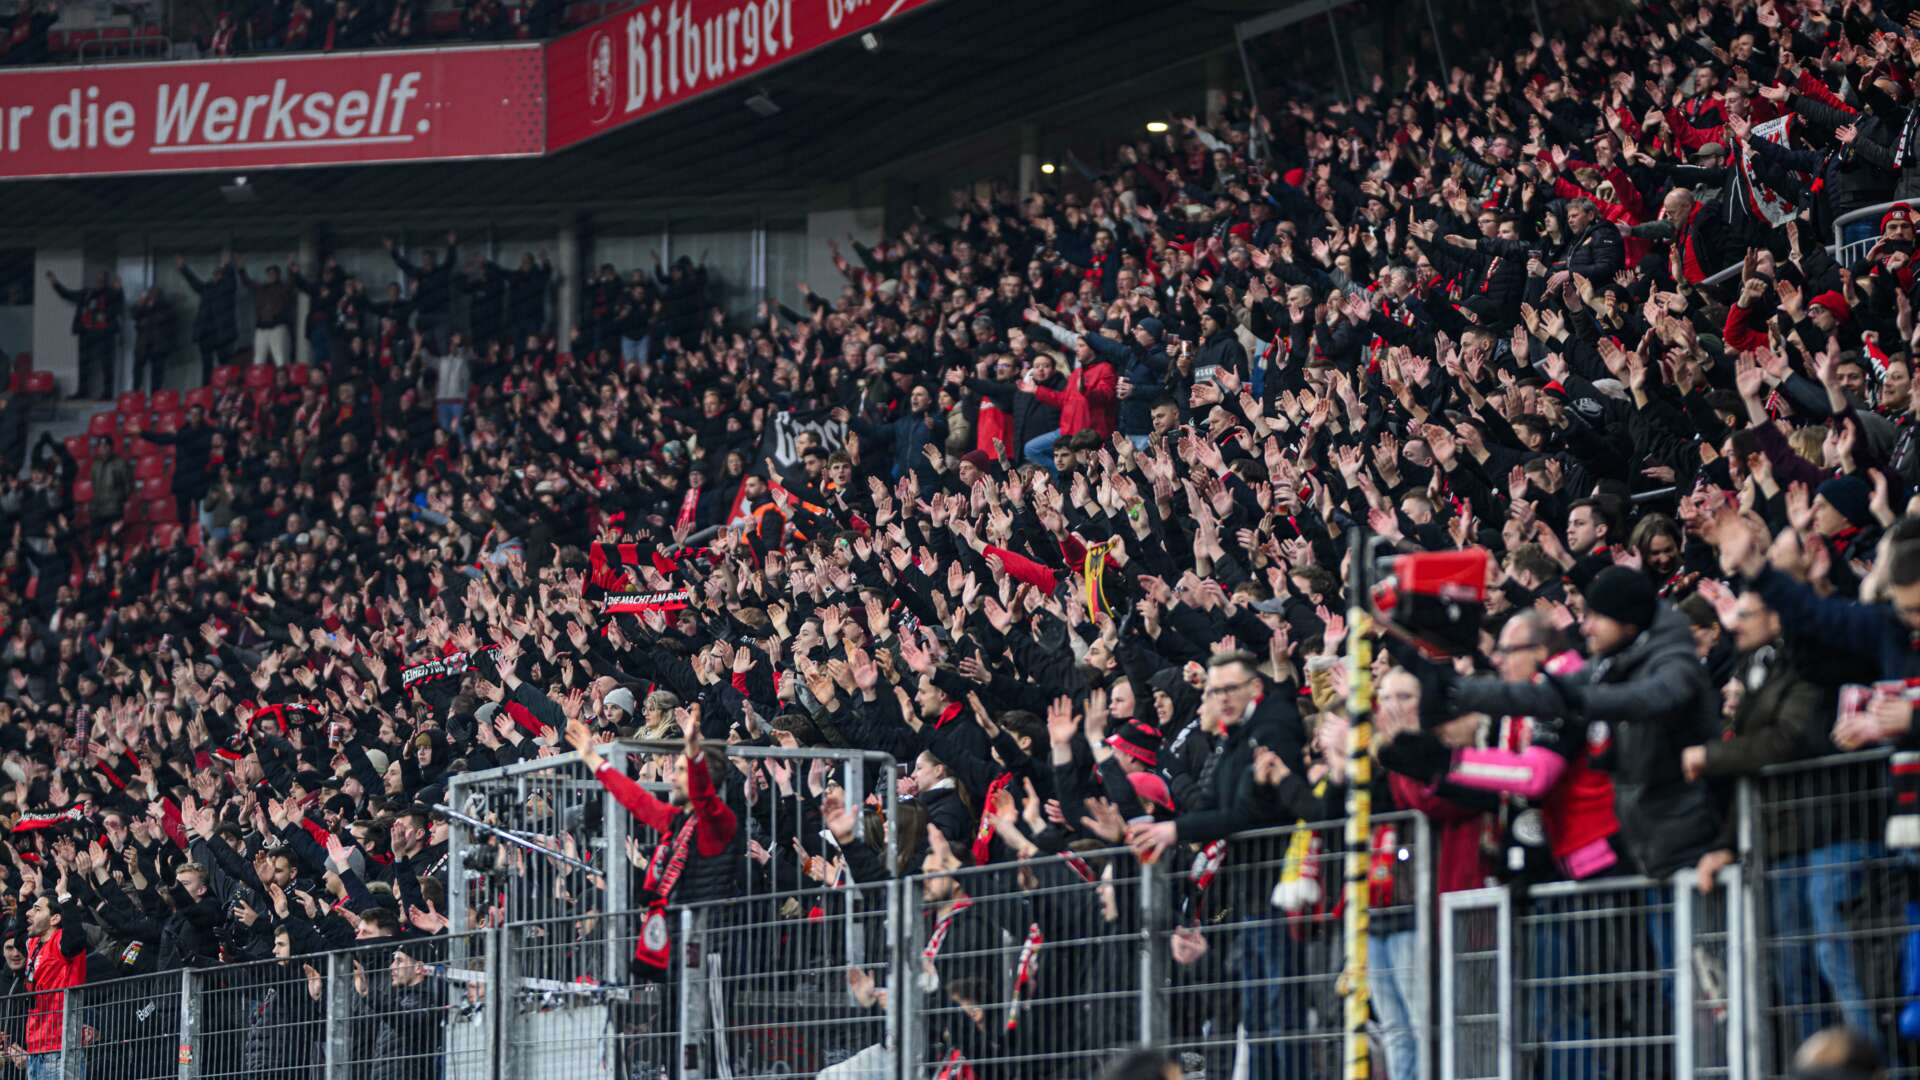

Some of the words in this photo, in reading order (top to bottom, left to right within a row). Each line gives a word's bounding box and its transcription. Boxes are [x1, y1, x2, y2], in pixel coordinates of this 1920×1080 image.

[625, 0, 794, 112] Bitburger
[48, 86, 135, 149] die
[156, 71, 431, 144] Werkself.
[621, 594, 651, 605] MACHT
[649, 592, 667, 604] AM
